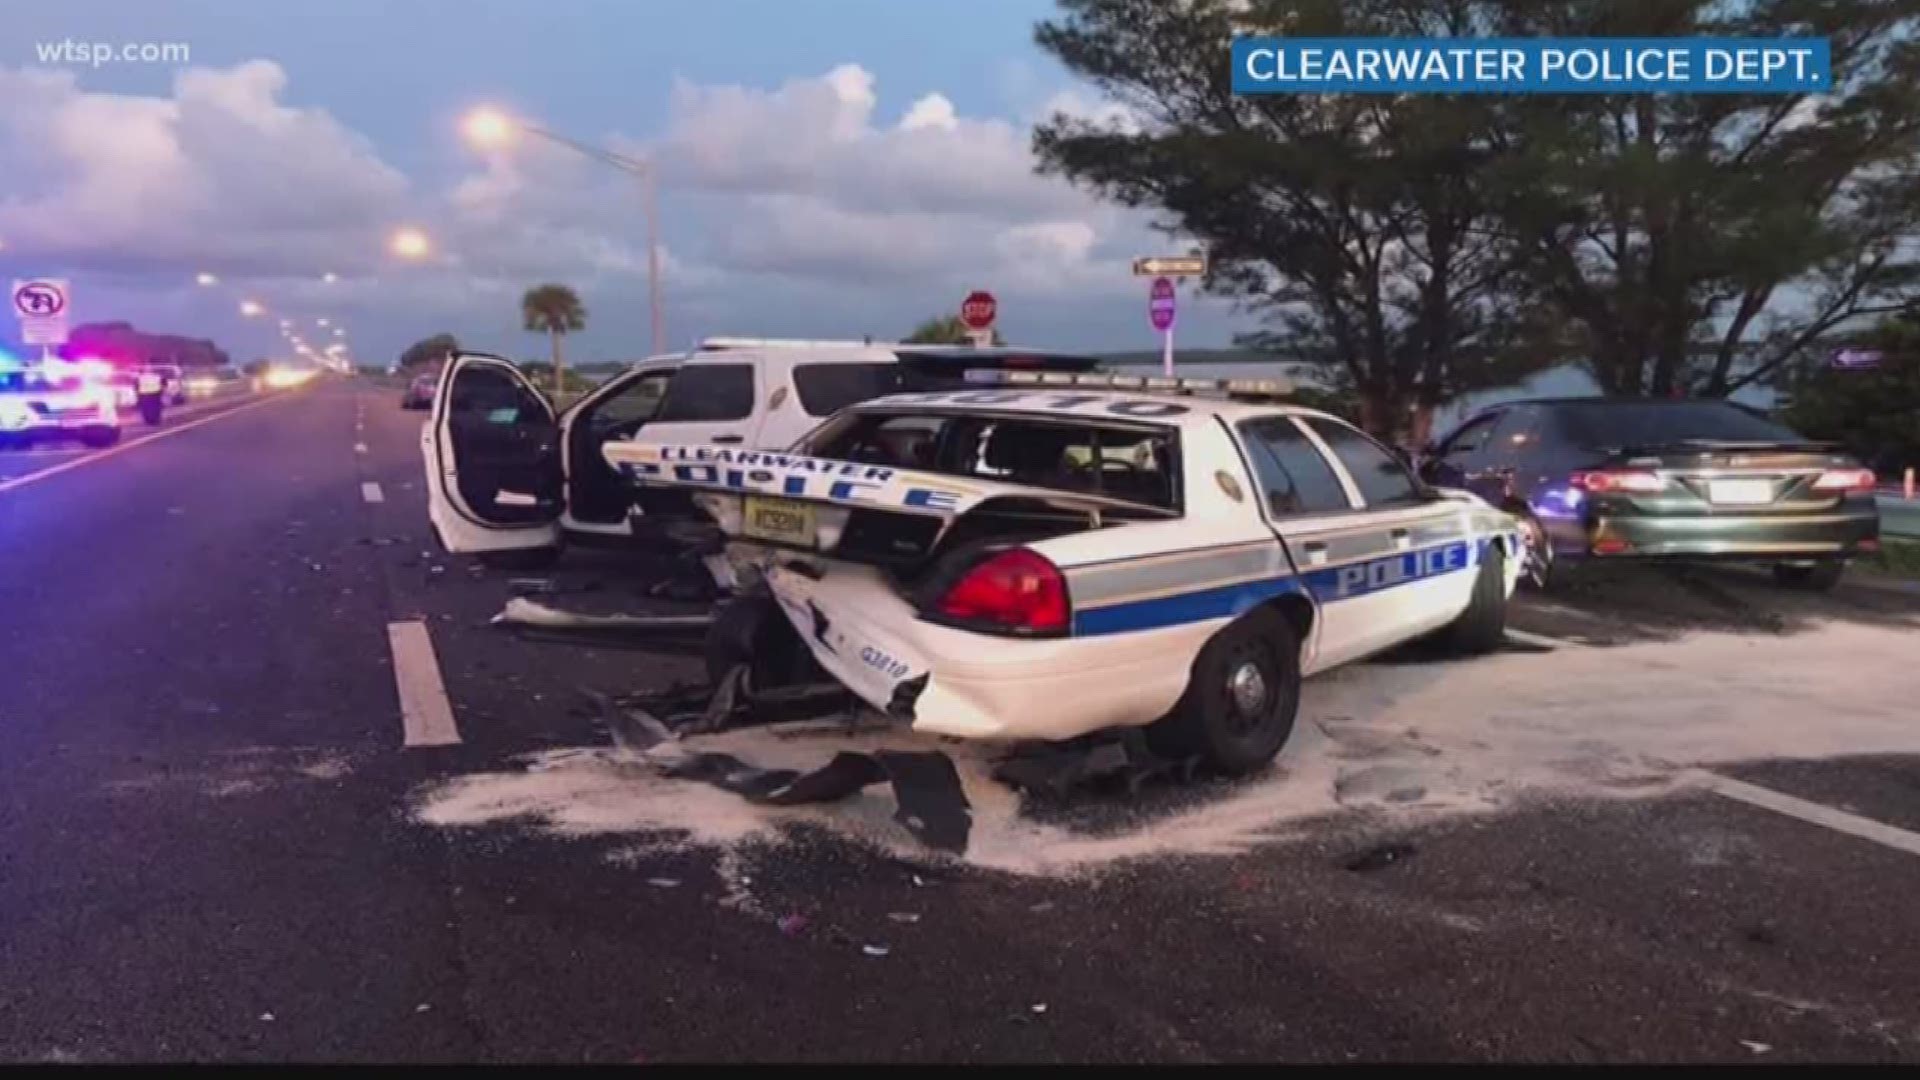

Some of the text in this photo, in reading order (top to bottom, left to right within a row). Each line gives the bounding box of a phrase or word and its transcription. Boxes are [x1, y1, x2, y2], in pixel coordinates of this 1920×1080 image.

[617, 462, 962, 510] POLICE
[660, 447, 893, 481] CLEARWATER
[1336, 545, 1462, 597] POLICE
